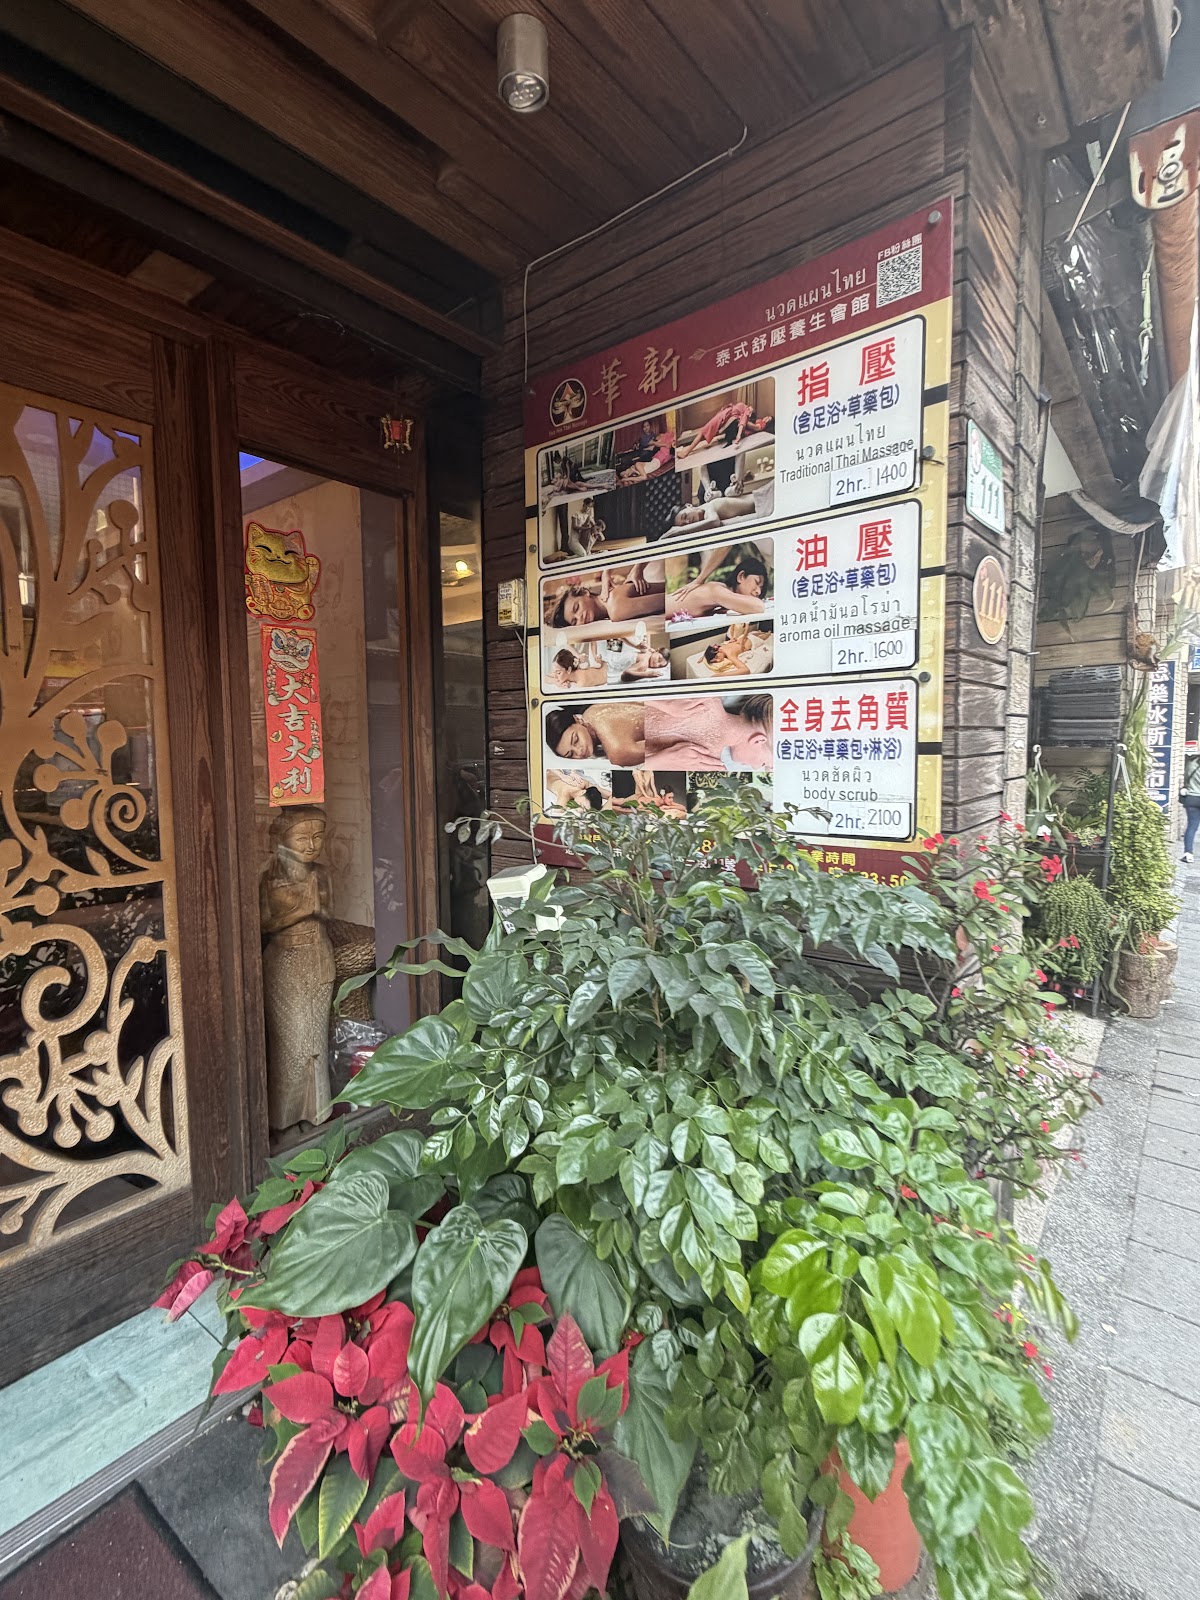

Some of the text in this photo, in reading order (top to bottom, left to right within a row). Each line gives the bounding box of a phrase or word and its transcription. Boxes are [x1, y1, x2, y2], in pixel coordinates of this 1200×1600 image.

[766, 268, 866, 322] นวดแผนไทย
[716, 293, 870, 368] 泰式舒壓養生會館
[797, 336, 896, 406] 指壓
[793, 383, 900, 435] (含足浴+草藥包)
[780, 438, 914, 483] Traditional Thai Massage
[796, 423, 886, 461] นวดแผนไทย
[876, 461, 907, 486] 1400
[981, 475, 1000, 519] 111
[795, 518, 893, 572] 油壓
[792, 562, 897, 598] (含足浴+草藥包)
[978, 578, 1003, 623] 111
[779, 618, 910, 642] aroma oil massage
[874, 639, 903, 659] 1600
[779, 691, 909, 732] 全身去角質
[277, 674, 313, 795] 大吉大利
[776, 738, 902, 761] (含足浴+草藥包+淋浴)
[804, 786, 878, 801] body scrub
[868, 809, 902, 826] 2100
[798, 848, 856, 866] 業時間
